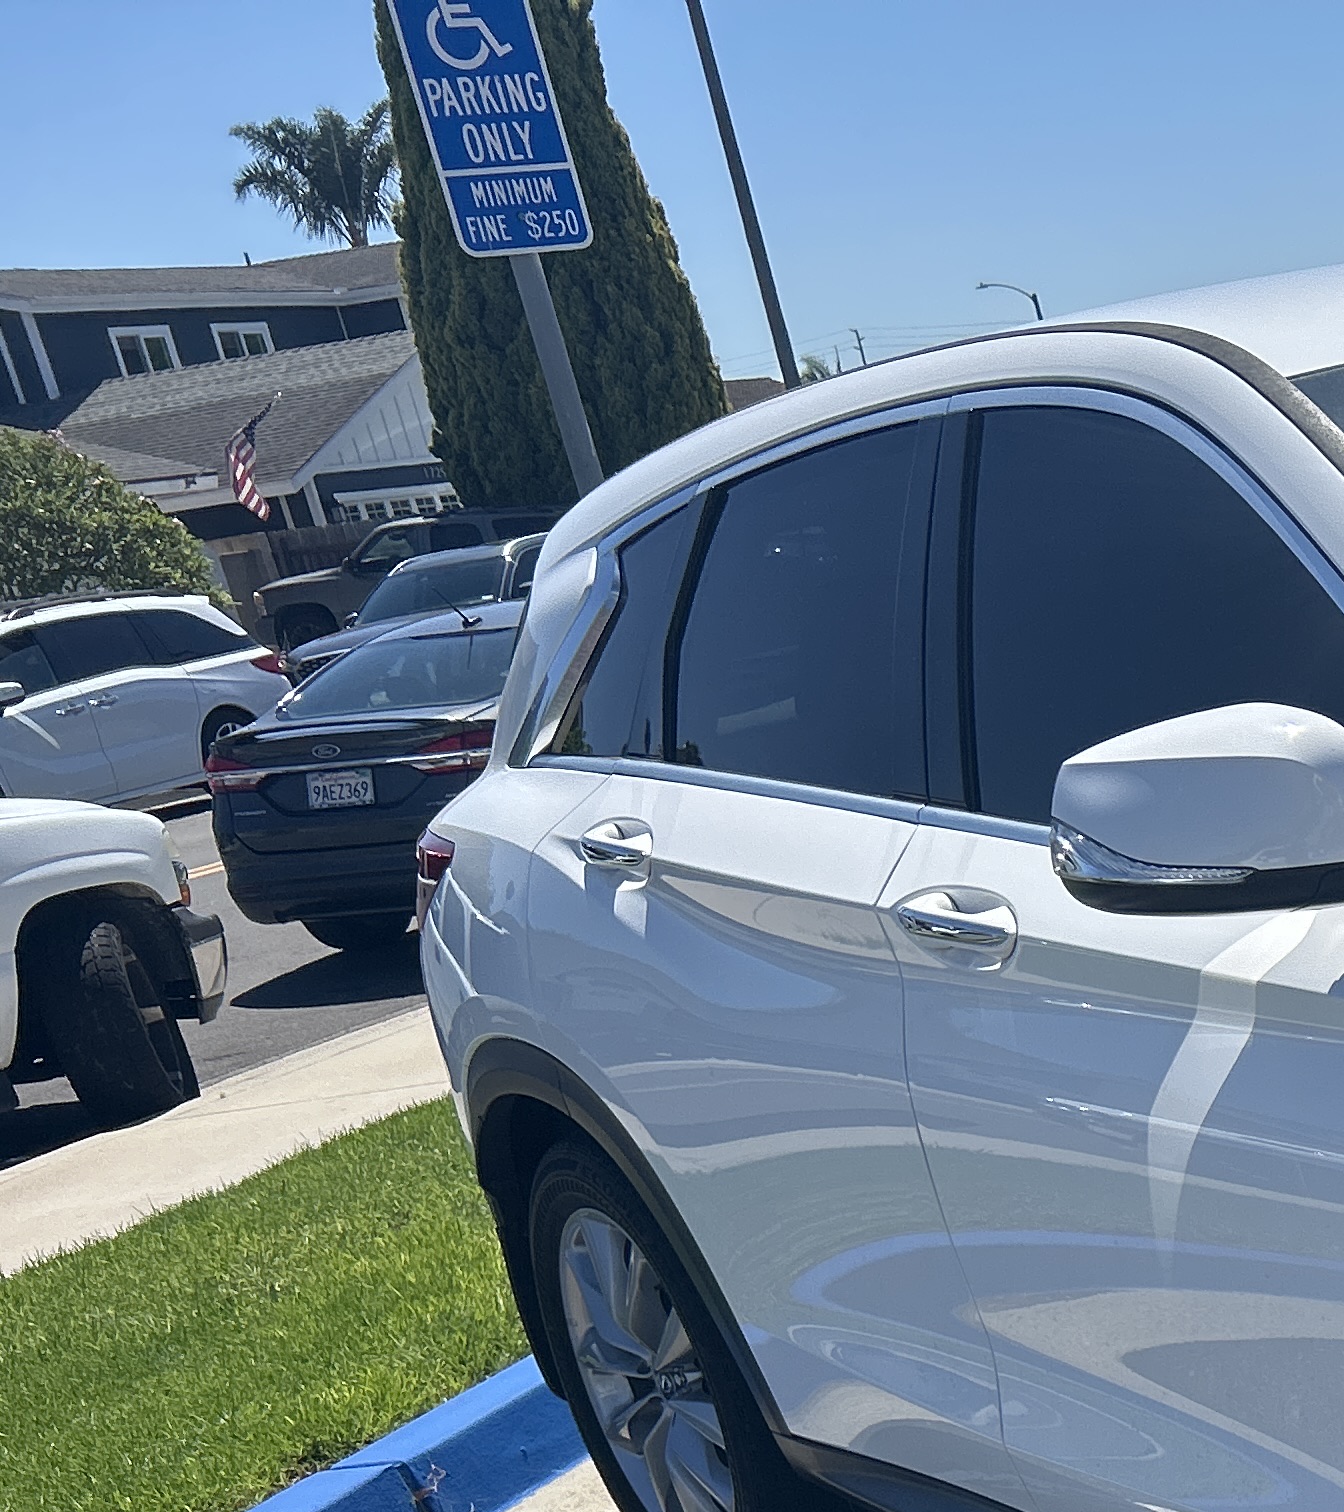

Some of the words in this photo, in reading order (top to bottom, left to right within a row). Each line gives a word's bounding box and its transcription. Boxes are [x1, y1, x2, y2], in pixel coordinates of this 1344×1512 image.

[423, 72, 547, 117] PARKING
[462, 120, 534, 164] ONLY
[470, 176, 558, 208] MINIMUM
[466, 214, 512, 243] FINE
[524, 208, 579, 241] $250
[313, 780, 369, 803] 9AEZ369
